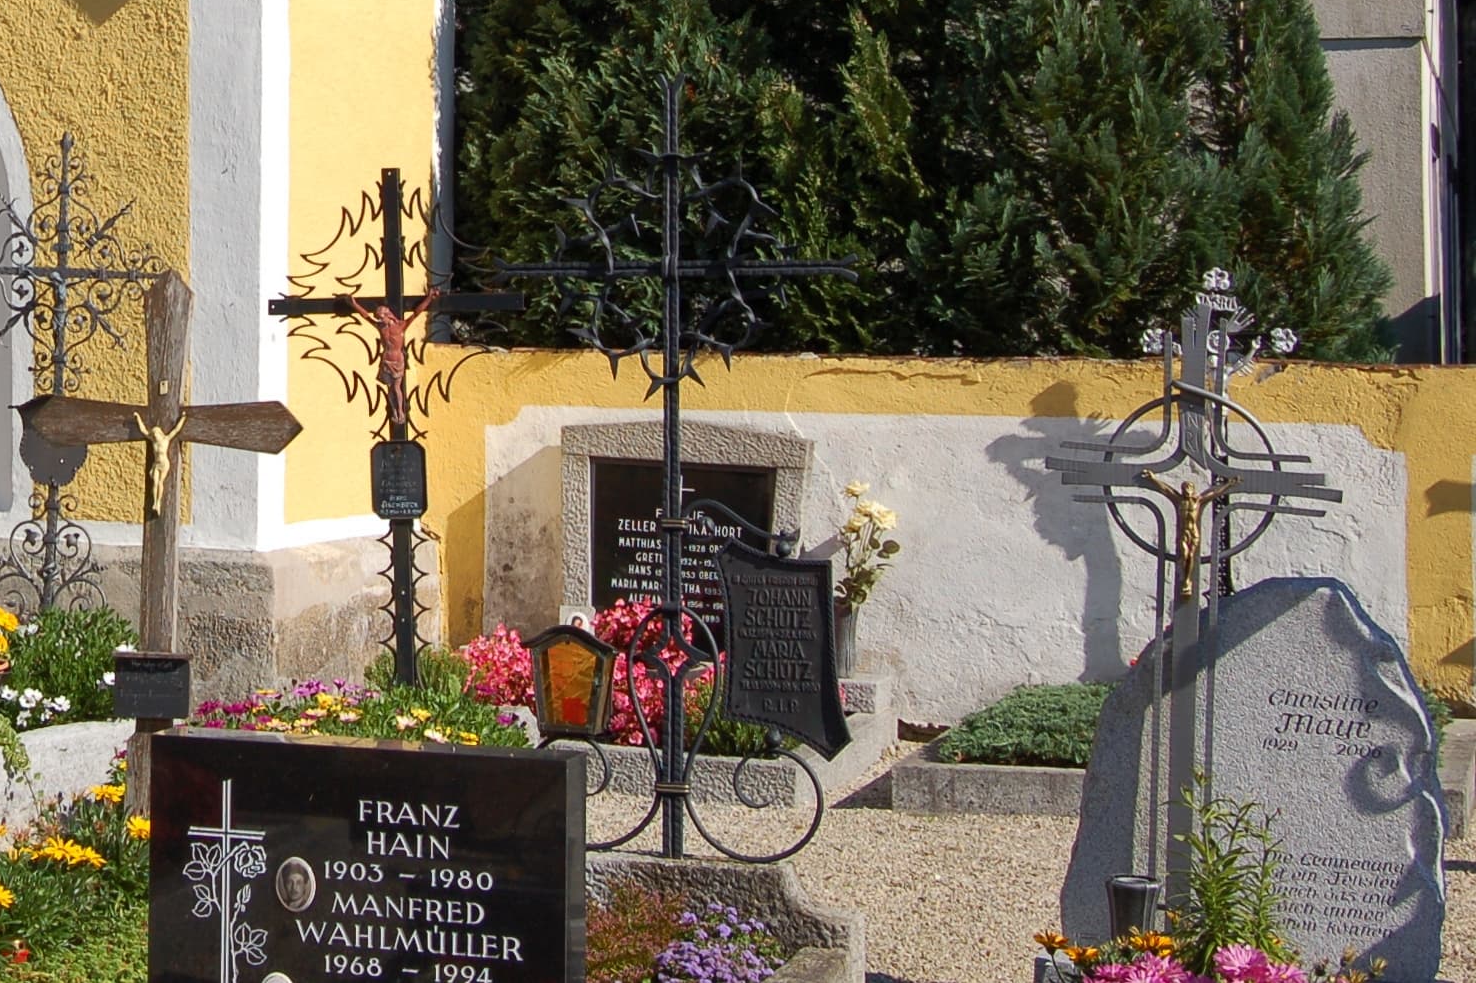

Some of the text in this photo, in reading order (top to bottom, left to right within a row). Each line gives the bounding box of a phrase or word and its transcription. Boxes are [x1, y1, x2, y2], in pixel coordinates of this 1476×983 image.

[618, 519, 657, 533] ZELLER
[714, 526, 742, 538] HORT
[618, 537, 662, 550] MATTHIAS
[628, 564, 652, 576] HANS
[611, 578, 638, 589] MARIA
[747, 588, 812, 606] JOHANN
[754, 640, 806, 659] MARIA
[1262, 737, 1299, 752] 1929
[358, 799, 460, 829] FRANZ
[366, 830, 450, 860] HAIN
[324, 860, 384, 883] 1903
[430, 868, 493, 891] 1980
[331, 892, 485, 925] MANFRED
[295, 919, 524, 962] WAHLMÜLLER
[324, 954, 383, 977] 1968
[434, 963, 493, 983] 1994
